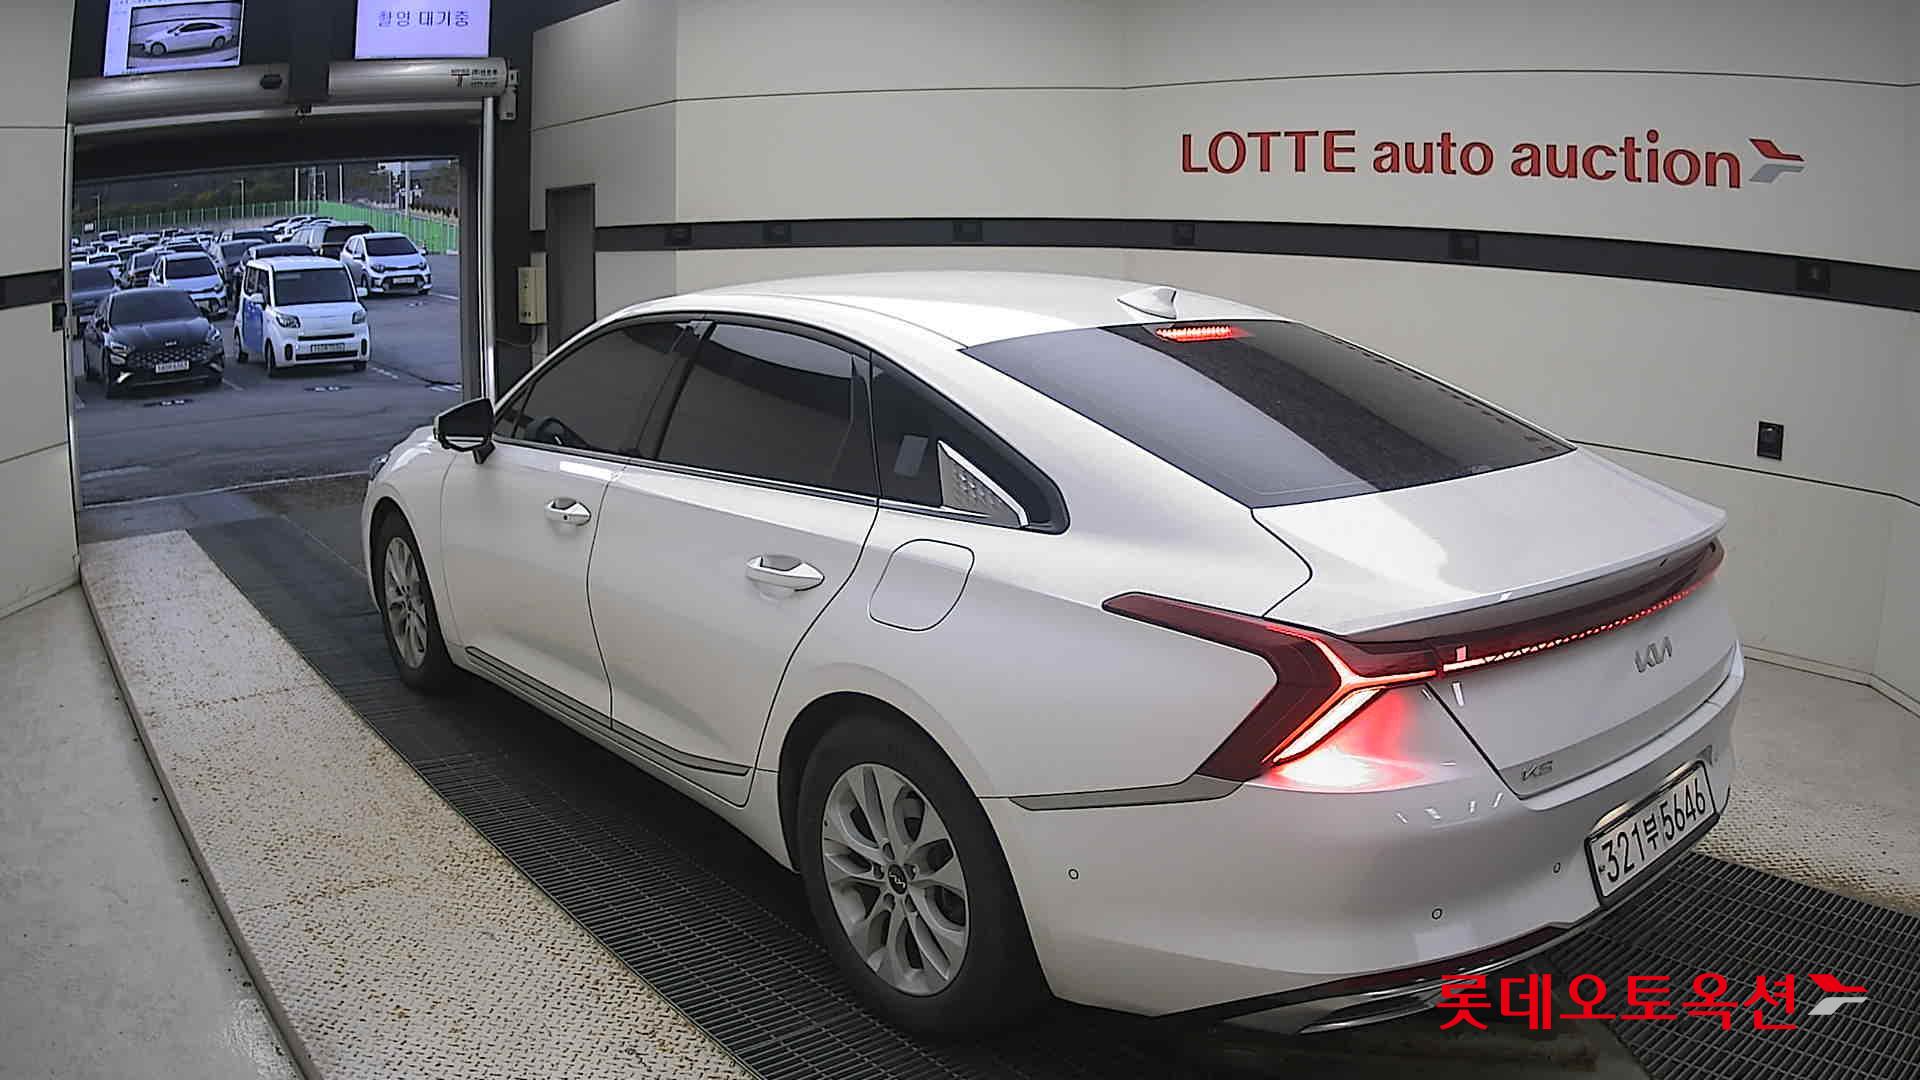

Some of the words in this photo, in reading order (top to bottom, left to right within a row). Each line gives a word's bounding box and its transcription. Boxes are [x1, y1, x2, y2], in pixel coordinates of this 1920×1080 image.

[419, 10, 469, 27] 대기중
[1181, 129, 1357, 174] LOTTE
[1372, 132, 1494, 175] auto
[1510, 129, 1742, 189] auction
